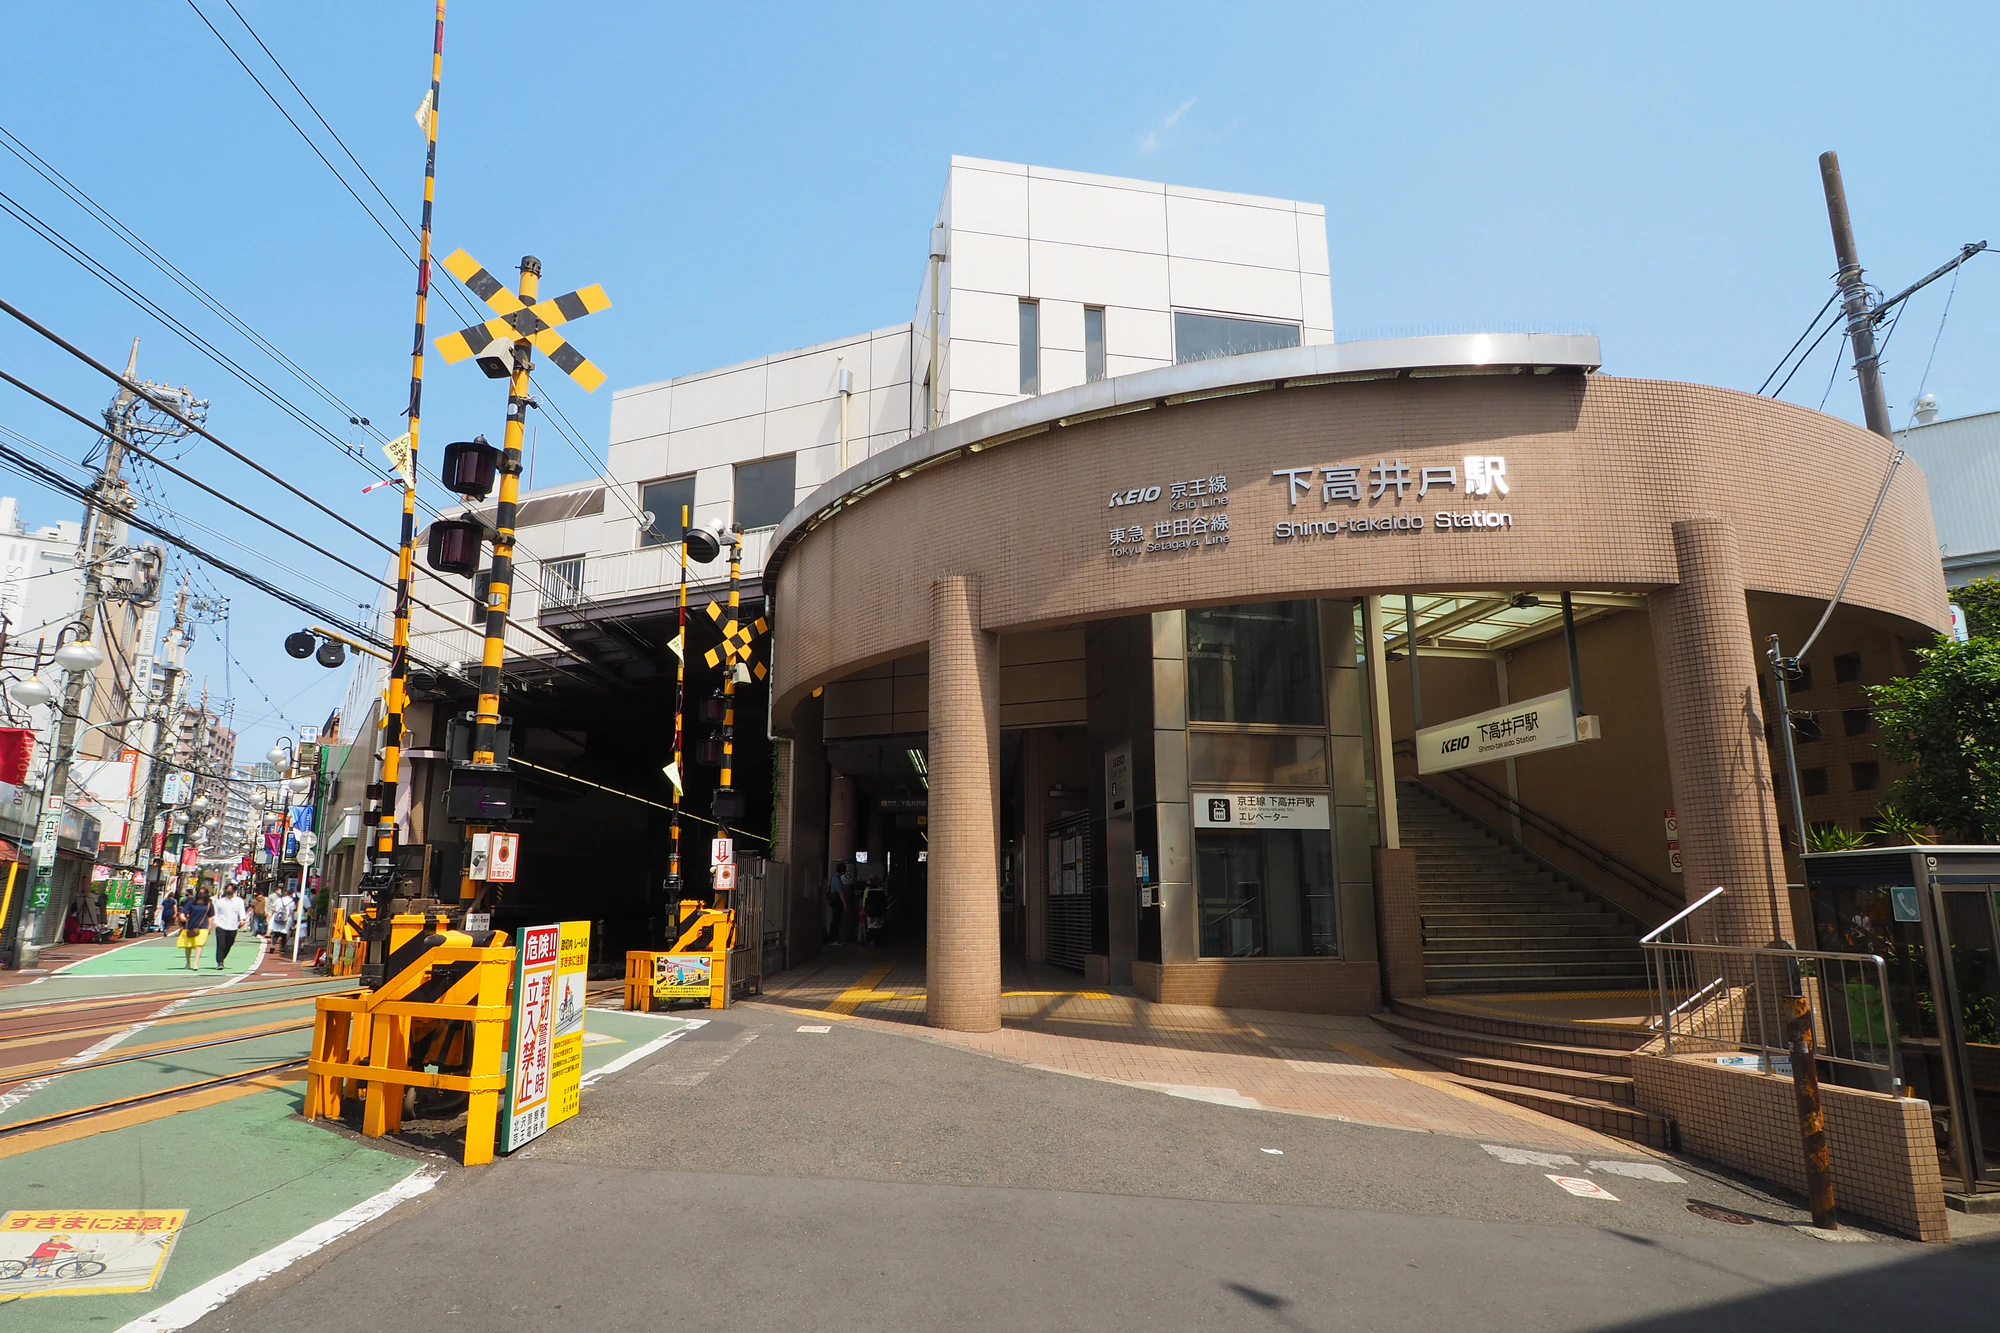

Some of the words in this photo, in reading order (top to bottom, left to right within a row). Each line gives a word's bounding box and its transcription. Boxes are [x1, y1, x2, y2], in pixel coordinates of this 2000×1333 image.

[1170, 475, 1228, 499] 京王線
[1272, 456, 1510, 505] 下高井戸駅
[1109, 486, 1162, 508] KEIO
[1201, 496, 1229, 508] Line
[1109, 525, 1145, 546] 東急
[1153, 513, 1230, 539] 世田谷線
[1276, 514, 1424, 538] Shimo-takaido
[1435, 511, 1513, 528] Station
[1110, 546, 1143, 557] Tokyu
[1146, 538, 1199, 552] Setagaya
[1205, 534, 1230, 545] Line
[1476, 711, 1540, 743] 下高井戸駅
[1440, 735, 1470, 754] KEIO
[1478, 739, 1516, 753] Shimo-takaido
[1516, 733, 1537, 746] Station
[1237, 796, 1266, 807] 京王線
[1269, 796, 1316, 808] 下高井戸駅
[1239, 812, 1289, 822] エレベーター
[44, 820, 55, 841] 立花
[518, 978, 540, 1103] 立入禁止
[534, 974, 551, 1094] 踏切警報時
